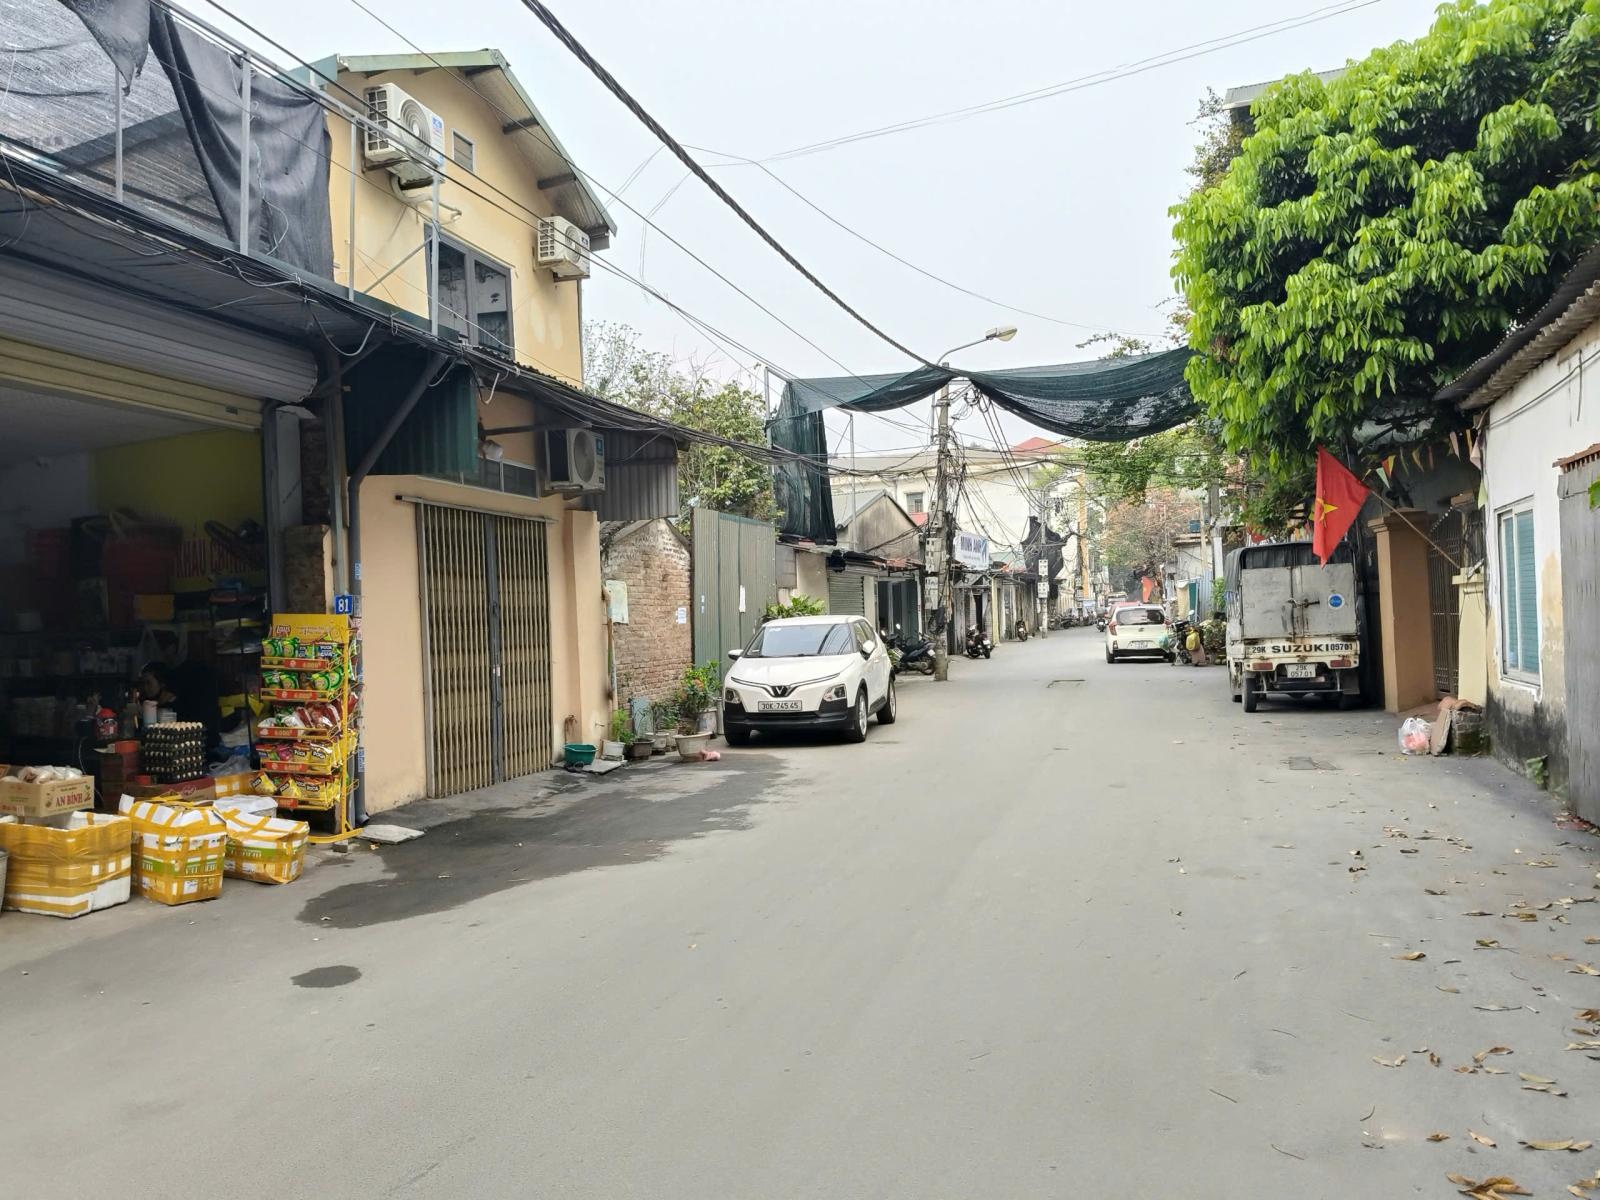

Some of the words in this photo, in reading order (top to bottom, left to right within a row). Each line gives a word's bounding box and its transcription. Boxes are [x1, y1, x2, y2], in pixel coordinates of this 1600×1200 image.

[338, 598, 349, 612] 81
[1252, 646, 1266, 654] 29K
[1271, 643, 1329, 653] SUZUKI
[56, 796, 65, 807] AN
